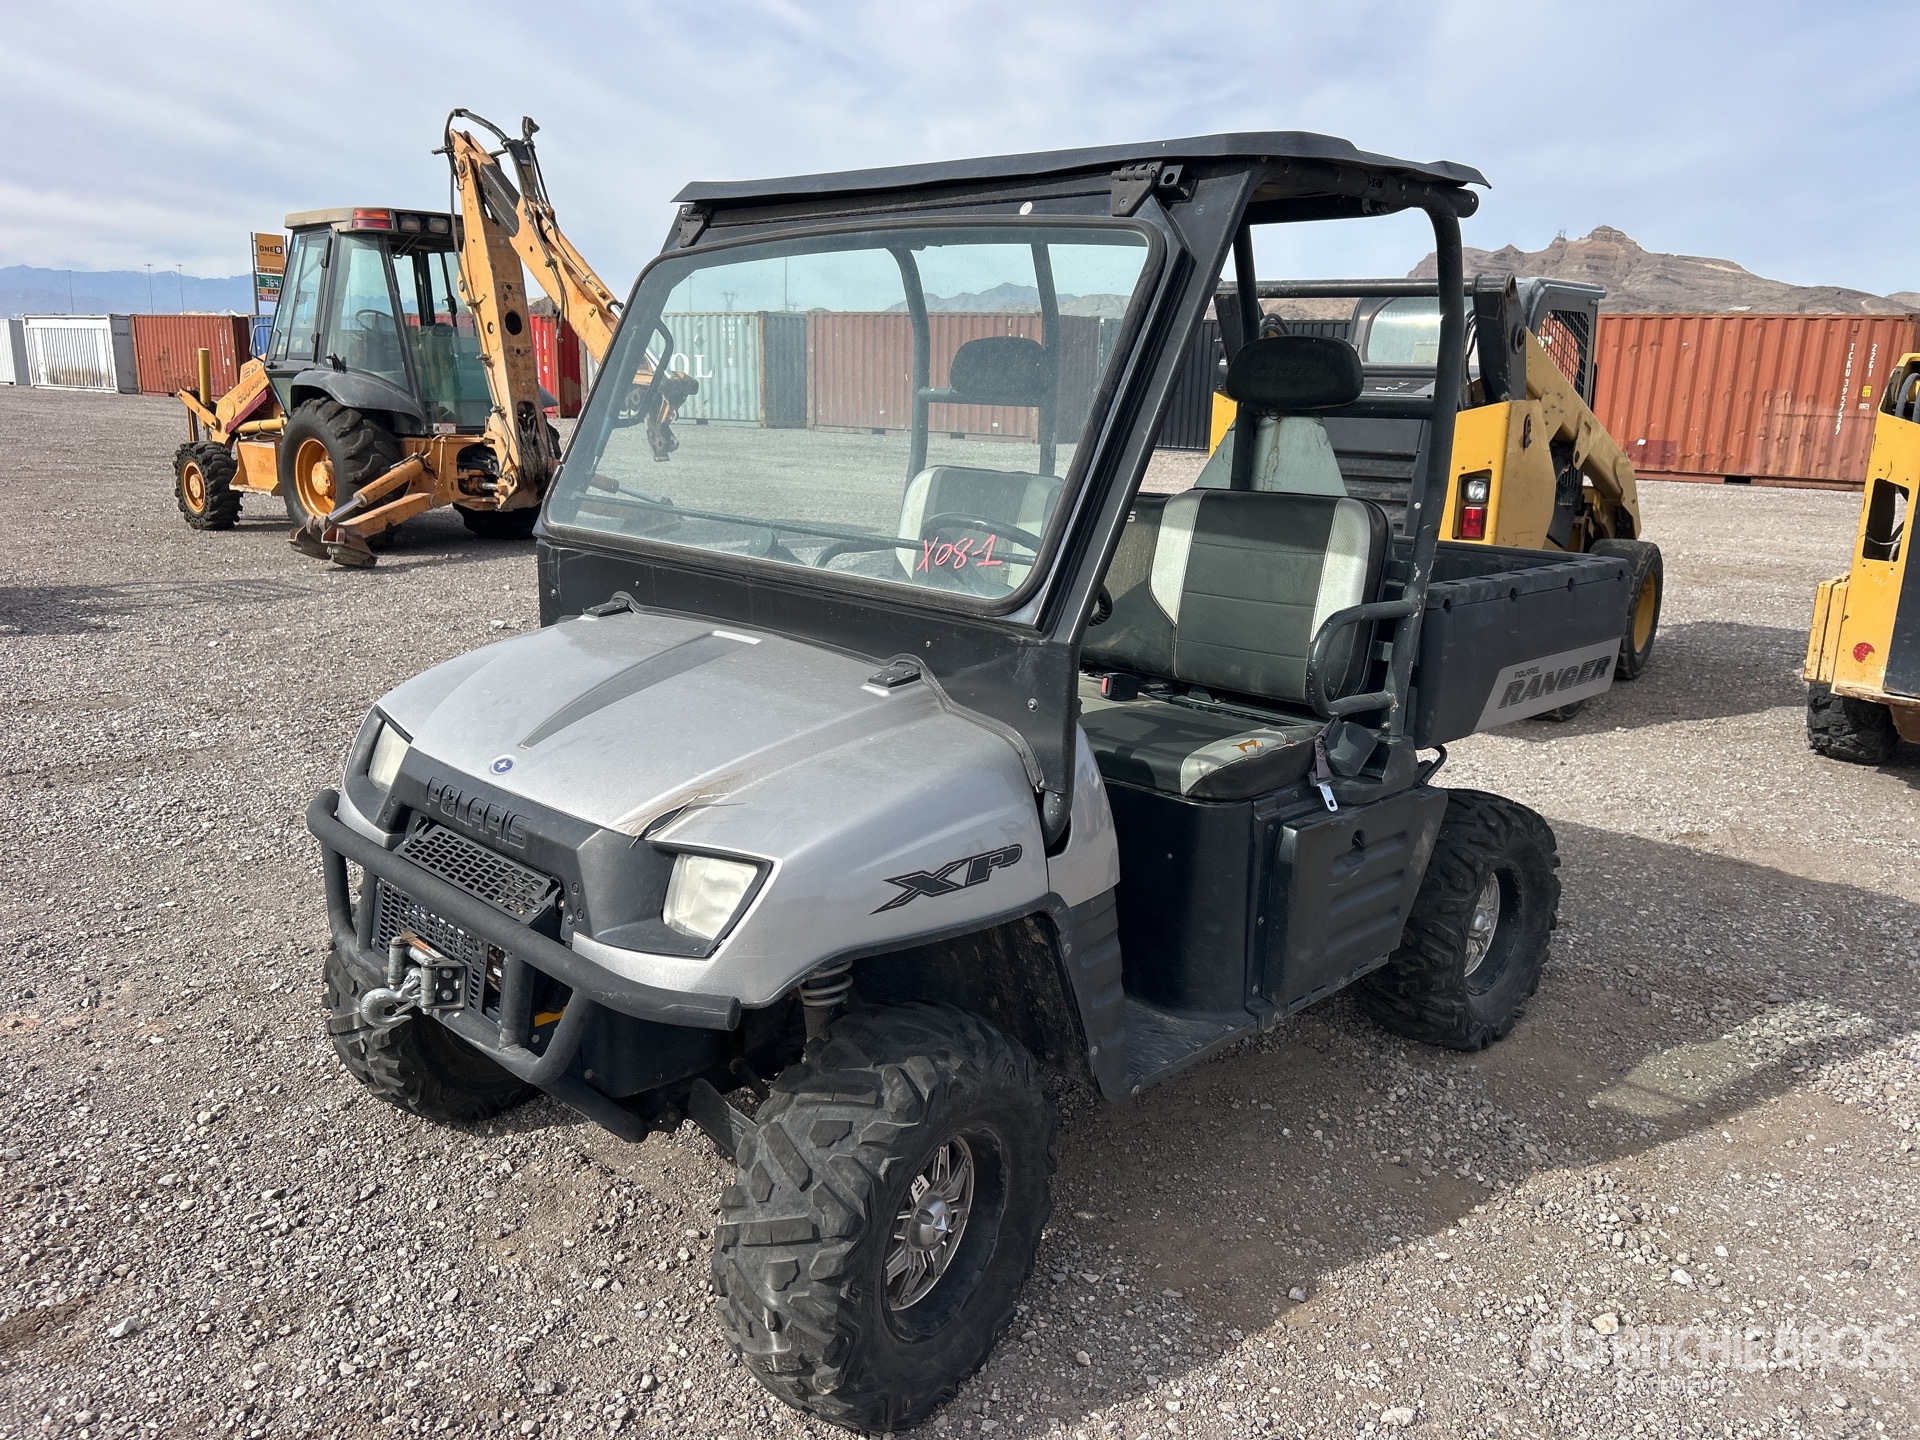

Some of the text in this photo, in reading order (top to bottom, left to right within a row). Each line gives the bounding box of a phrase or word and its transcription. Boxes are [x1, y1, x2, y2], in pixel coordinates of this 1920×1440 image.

[265, 279, 279, 287] 364
[1835, 343, 1855, 435] TCKU 3957527
[916, 534, 1003, 573] X08-1
[1498, 655, 1611, 709] RANGER
[1514, 666, 1539, 680] POLARIS
[426, 776, 532, 849] POLARIS
[869, 844, 1023, 915] XP
